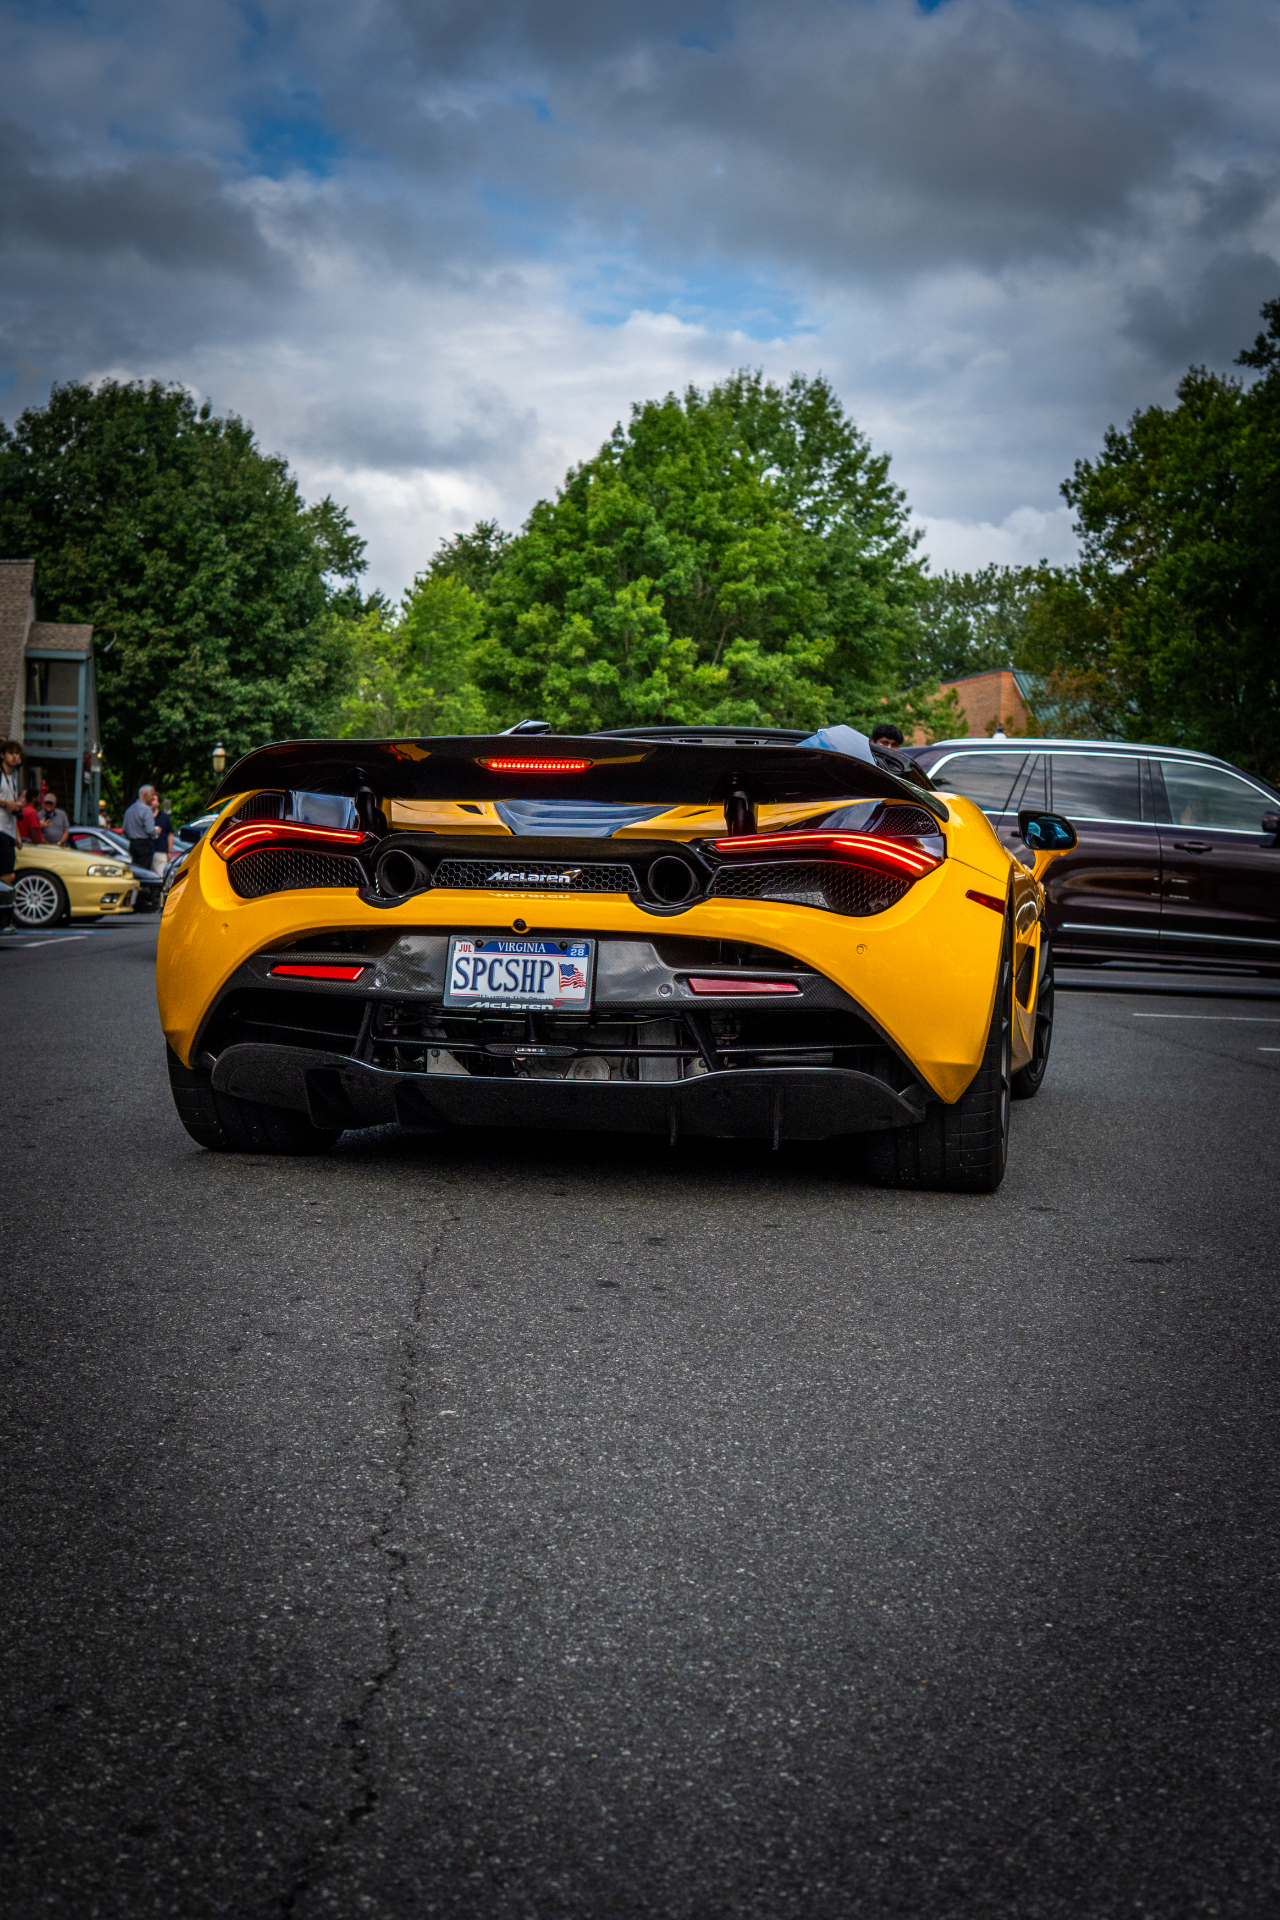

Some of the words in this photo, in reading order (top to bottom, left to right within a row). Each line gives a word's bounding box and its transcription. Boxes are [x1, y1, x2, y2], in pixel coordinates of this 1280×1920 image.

[486, 871, 571, 883] McLaren
[457, 943, 472, 953] JUL
[497, 941, 547, 954] VIRGINIA
[570, 948, 585, 957] 28
[453, 956, 555, 993] SPCSHP
[467, 1001, 554, 1011] McLaren
